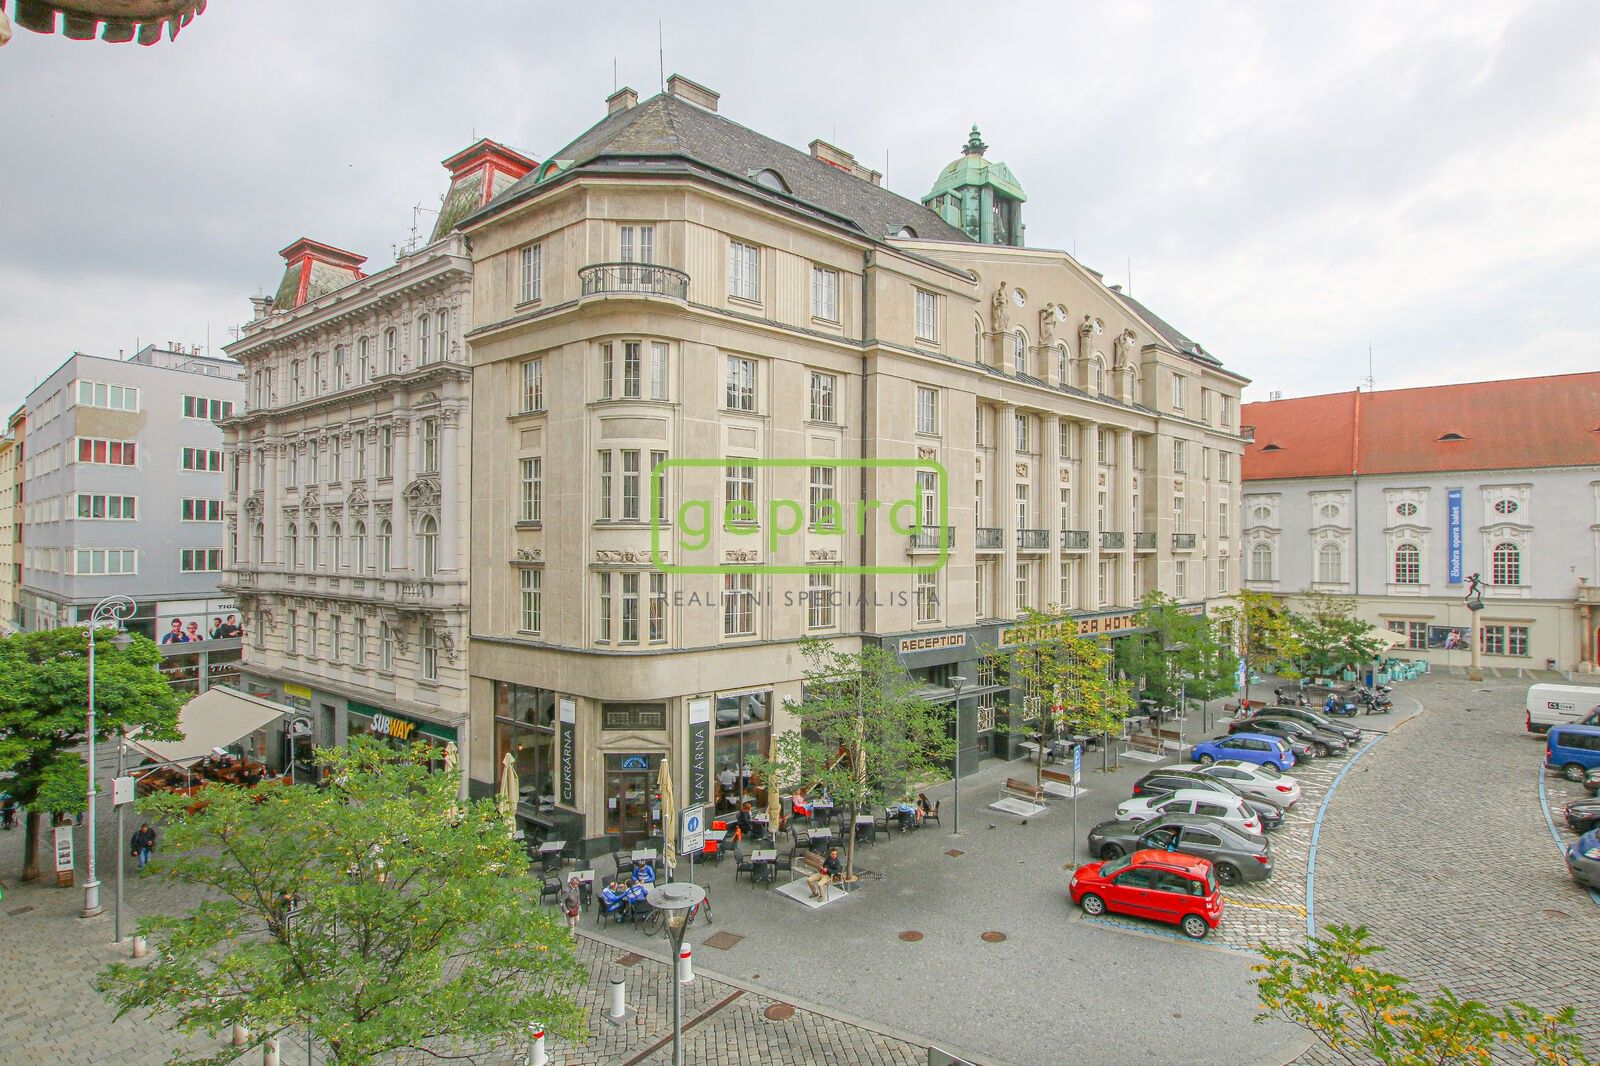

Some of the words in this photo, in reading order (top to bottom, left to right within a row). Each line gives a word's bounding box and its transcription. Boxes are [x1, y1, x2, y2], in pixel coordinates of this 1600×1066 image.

[1450, 506, 1460, 525] balet
[1452, 527, 1461, 548] opera
[1450, 550, 1460, 577] činohra
[1104, 615, 1138, 630] HOTE
[901, 634, 964, 651] RECEPTION
[370, 713, 415, 740] SUBWAY
[563, 730, 572, 800] CUKRÁRNA
[693, 729, 704, 800] KAVÁRNA
